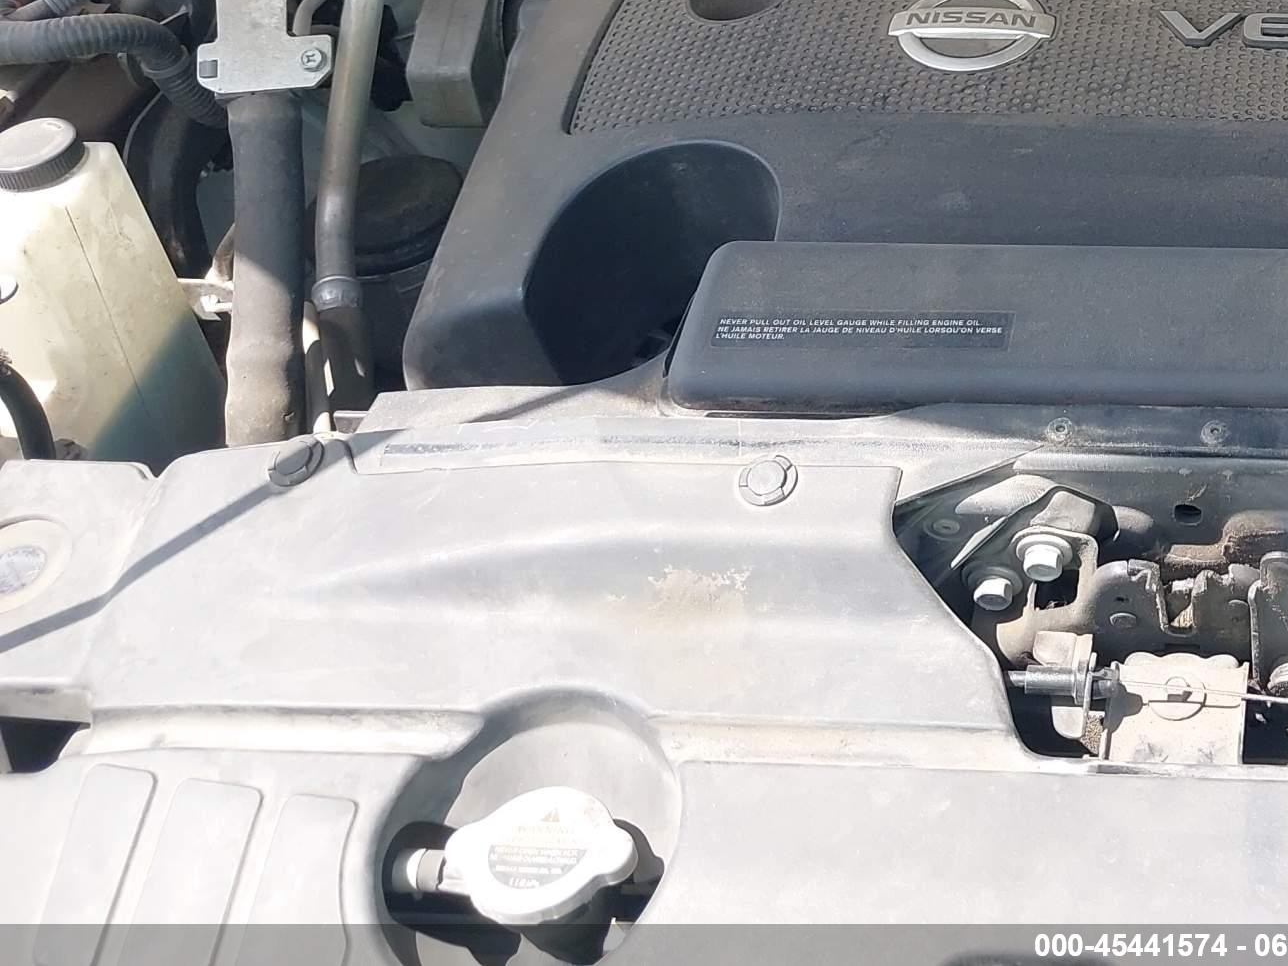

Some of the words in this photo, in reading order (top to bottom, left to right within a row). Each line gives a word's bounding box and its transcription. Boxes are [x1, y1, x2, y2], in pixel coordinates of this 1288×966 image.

[905, 9, 1037, 27] NISSAN
[719, 318, 748, 326] NEVER
[749, 318, 770, 326] PULL
[772, 318, 791, 326] OUT
[792, 318, 807, 326] OIL
[812, 326, 840, 334] JAUGE
[841, 326, 854, 334] DE
[855, 326, 887, 334] NIVEAU
[888, 326, 922, 334] D'HUILE
[923, 326, 973, 334] LORSQU'ON
